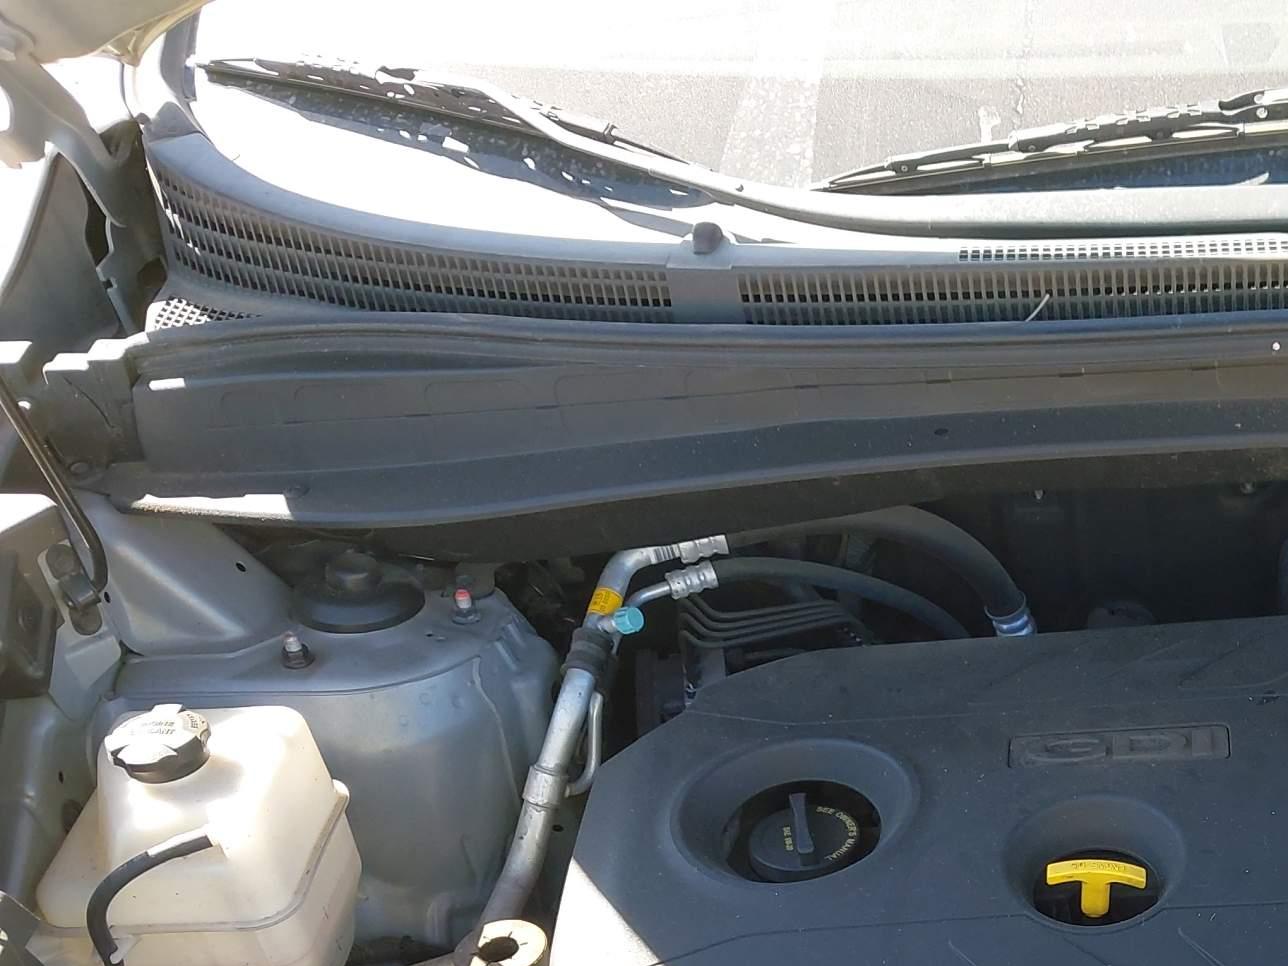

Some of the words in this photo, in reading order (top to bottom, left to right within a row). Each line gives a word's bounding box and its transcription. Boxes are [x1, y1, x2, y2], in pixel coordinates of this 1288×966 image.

[1020, 728, 1216, 763] GDI
[815, 806, 835, 815] SEE
[824, 838, 856, 861] MANUAL
